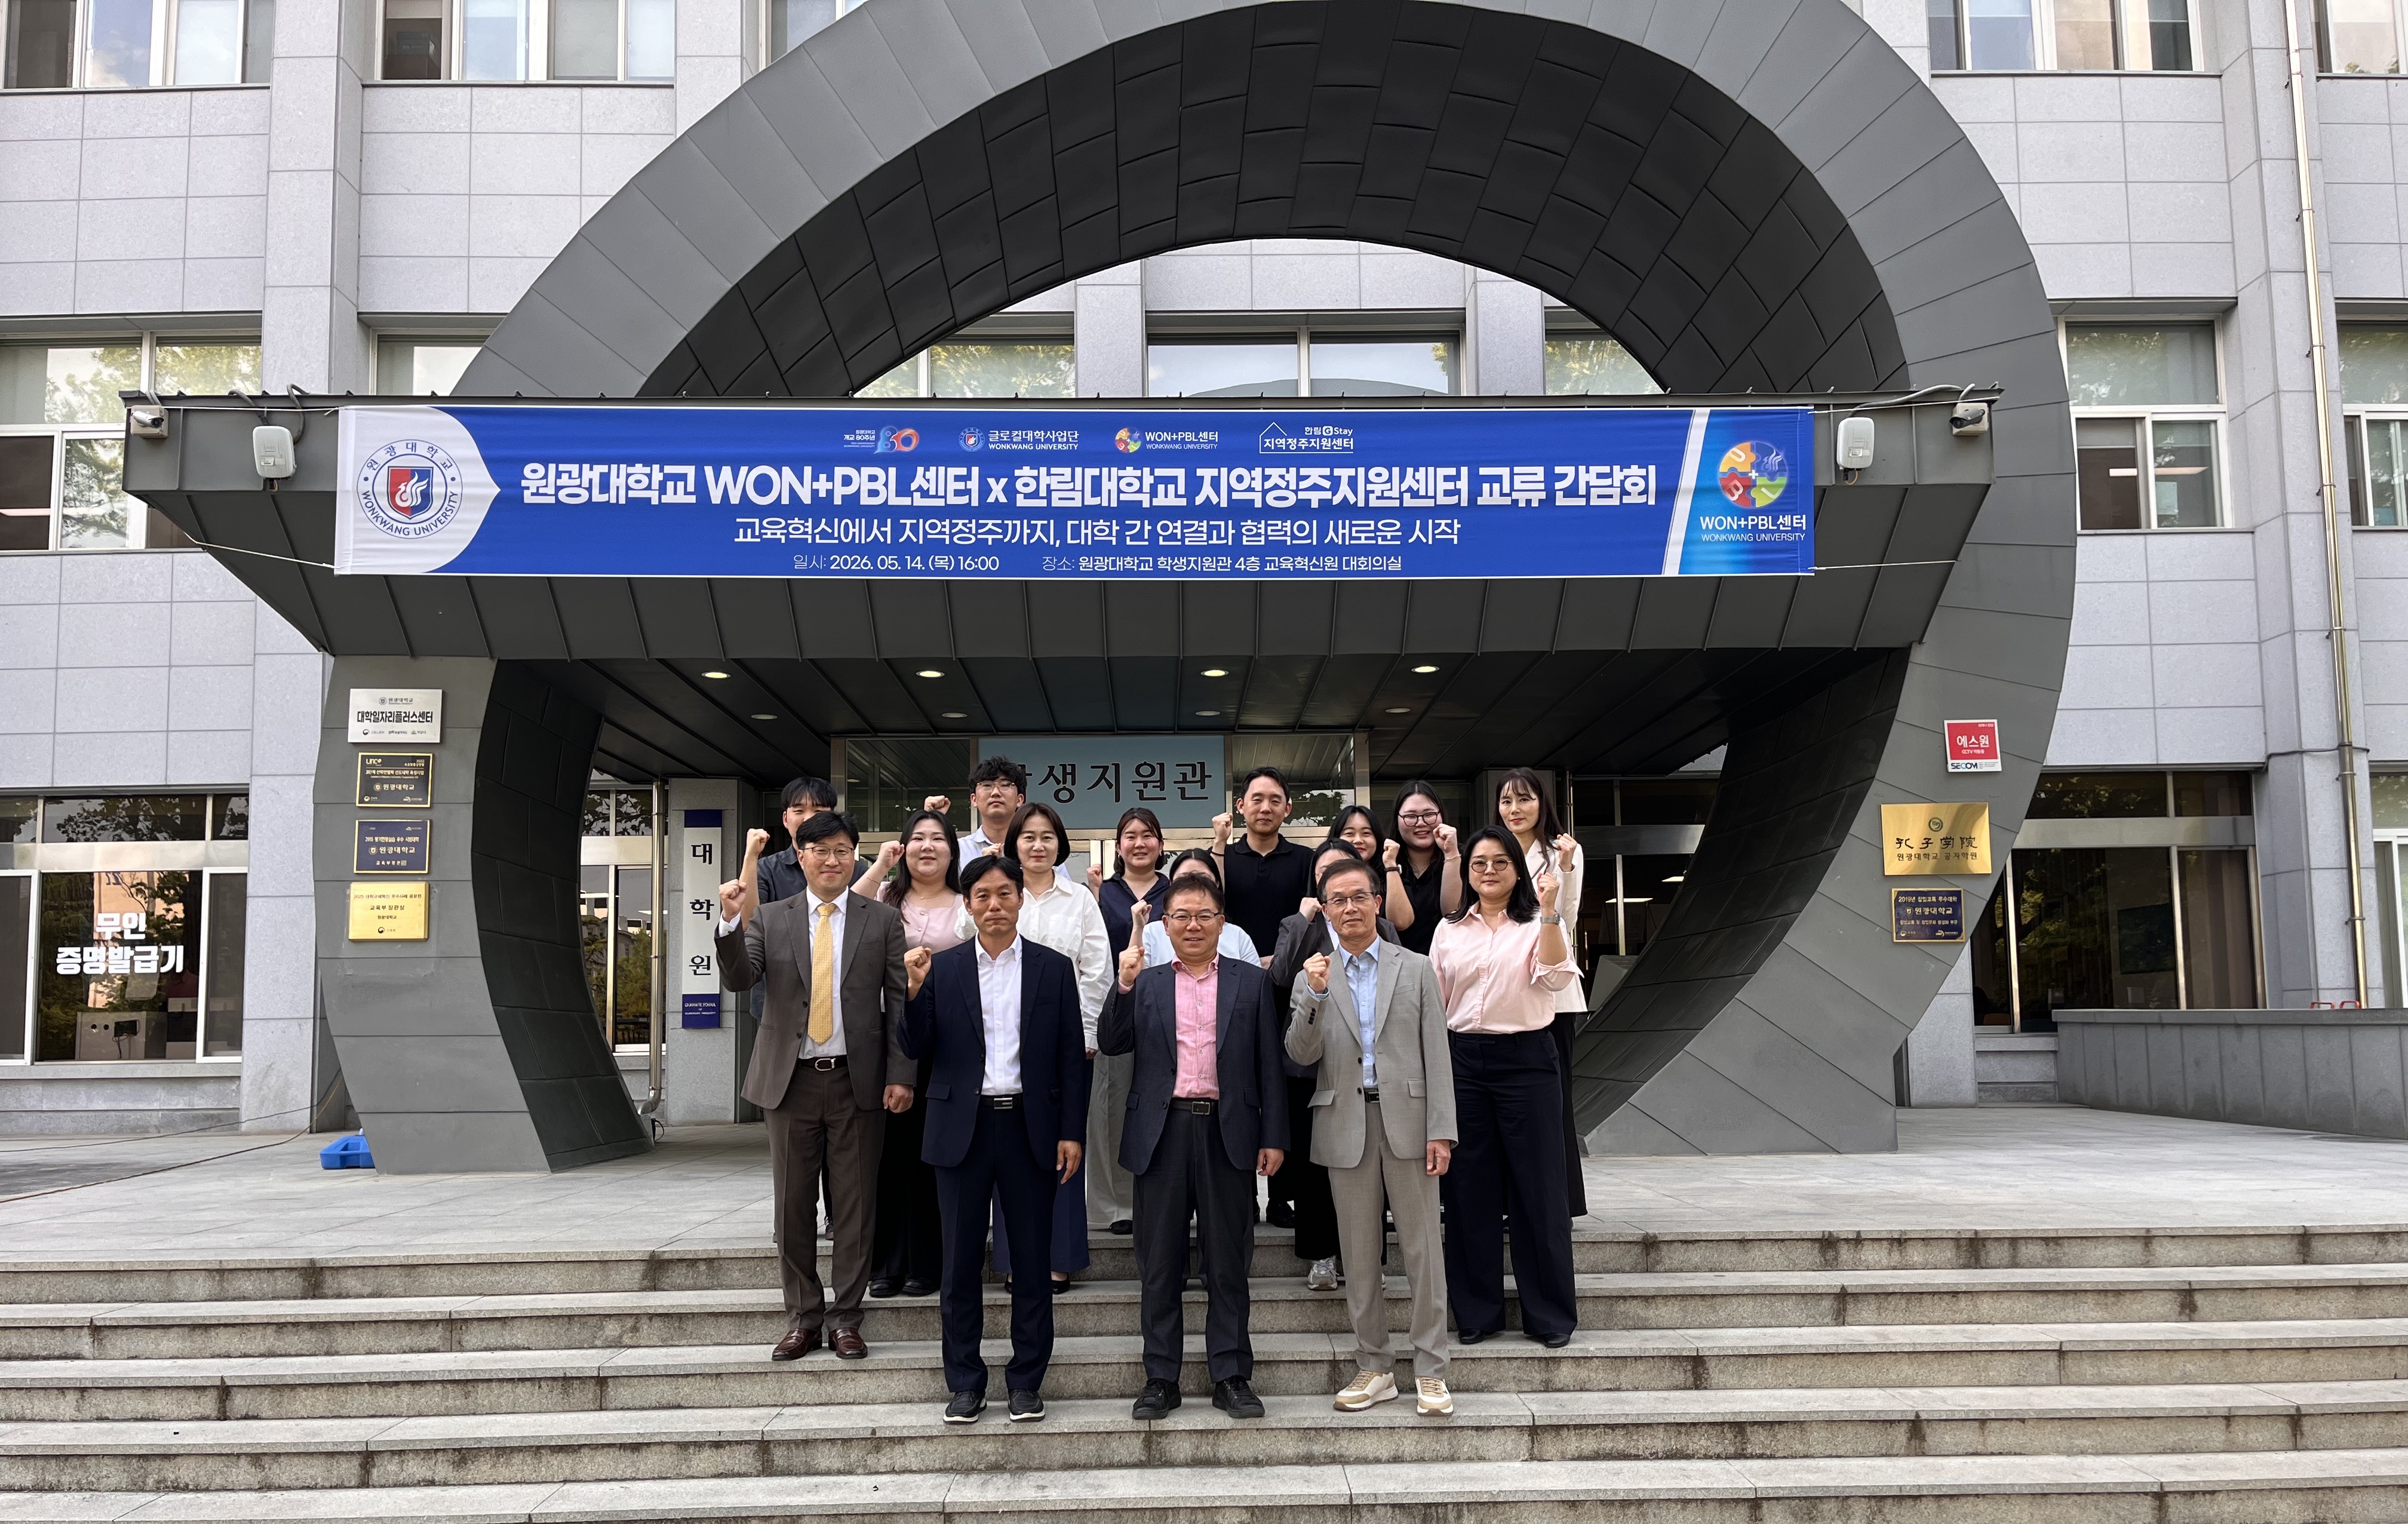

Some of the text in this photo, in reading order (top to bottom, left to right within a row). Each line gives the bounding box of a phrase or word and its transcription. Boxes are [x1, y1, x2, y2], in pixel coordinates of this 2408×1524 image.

[988, 429, 1080, 442] 글로컬대학사업단
[1145, 431, 1218, 443] WON+PBL센터
[1264, 438, 1353, 450] 지역정주지원센터
[367, 443, 453, 471] 원광대학교
[521, 462, 696, 505] 원광대학교
[704, 465, 979, 506] WON+PBL센터
[1015, 466, 1187, 508] 한림대학교
[1196, 466, 1469, 508] 지역정주지원센터
[1477, 466, 1546, 507] 교류
[1555, 465, 1656, 506] 간담회
[362, 490, 458, 536] WONKWANG UNIVERSITY
[1700, 514, 1806, 530] WON+PBL센터
[734, 517, 1461, 548] 교육혁신에서 지역정주까지, 대학 간 연결과 협력의 새로운 시작
[1701, 533, 1805, 542] WONKWANG UNIVERSITY
[793, 554, 1402, 572] 일시: 2026. 05. 14. (목) 16:00 장소: 원광대학교 학생지원관 4층 교육혁신원 대회의실
[357, 711, 433, 723] 대학일자리플러스센터
[1956, 735, 1989, 748] 에스원
[689, 843, 715, 976] 대학원
[96, 912, 146, 940] 무인
[56, 945, 184, 975] 증명발급기
